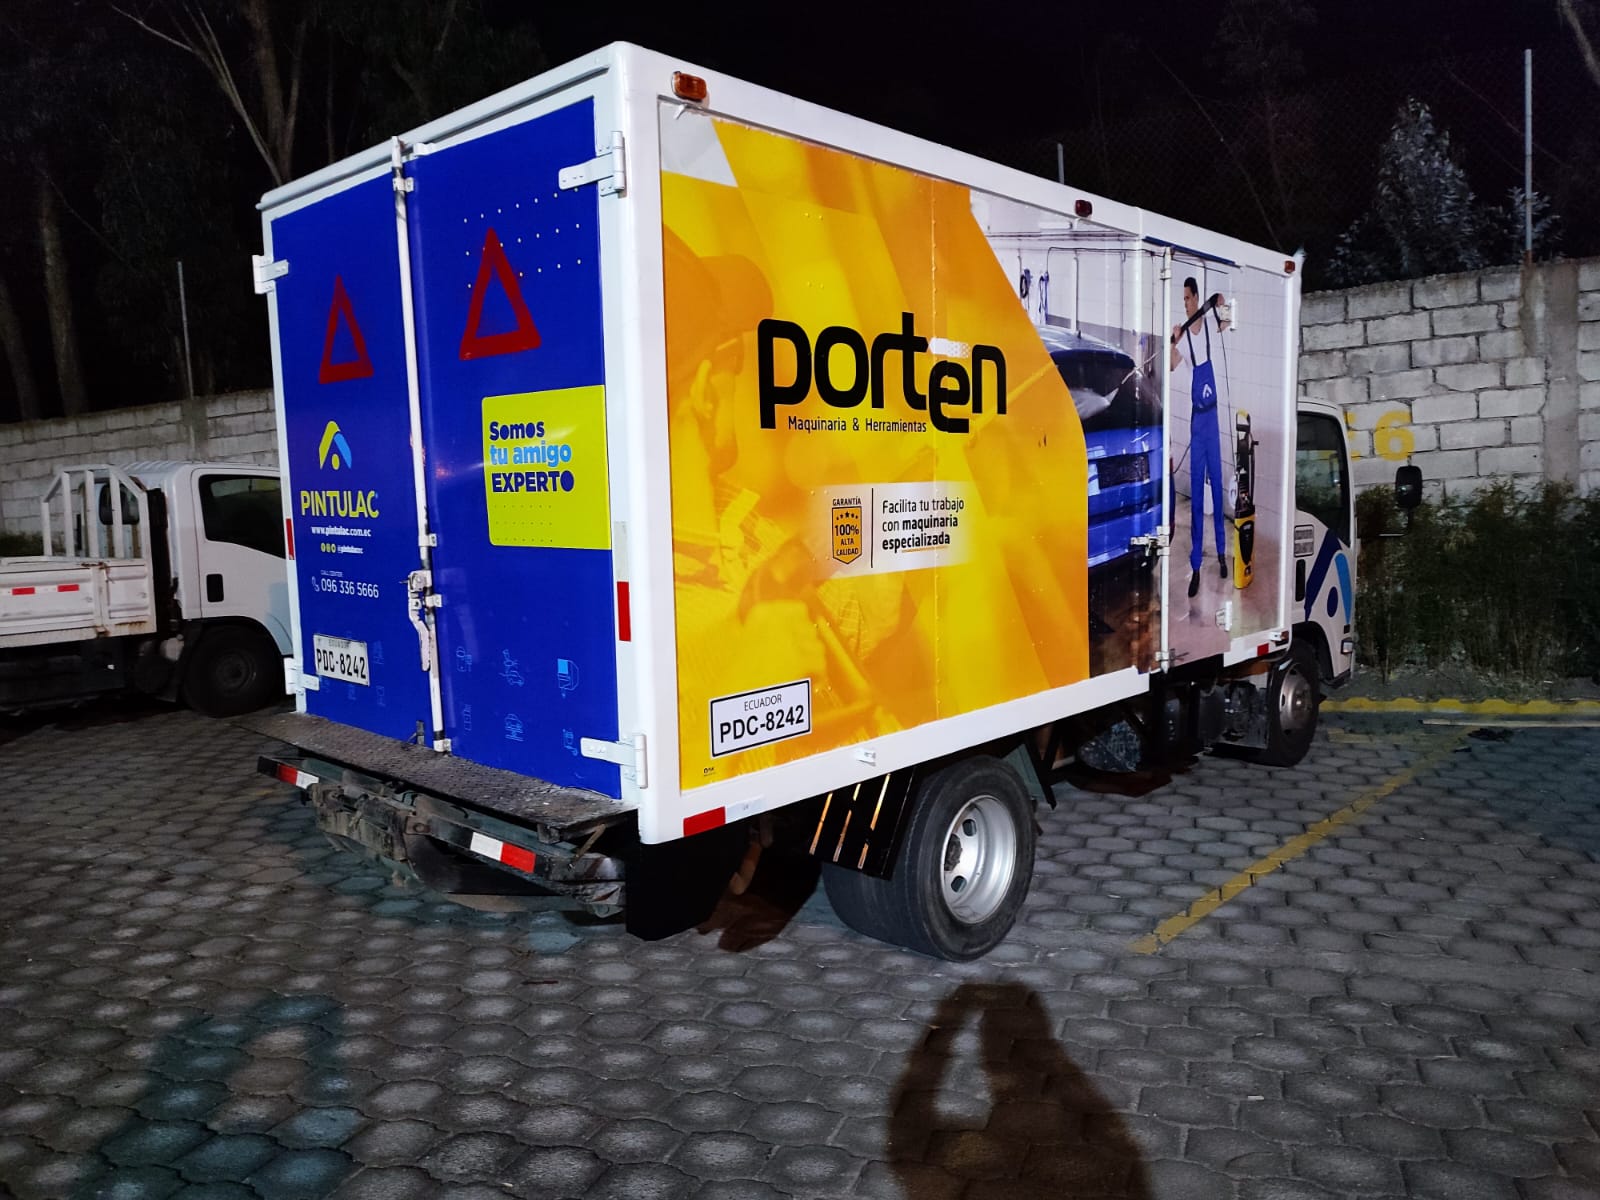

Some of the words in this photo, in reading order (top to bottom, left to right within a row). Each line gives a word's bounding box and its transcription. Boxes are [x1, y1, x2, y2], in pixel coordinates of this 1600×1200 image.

[758, 312, 1007, 433] porten
[489, 421, 545, 441] Somos
[788, 415, 847, 434] Maquinaria
[852, 417, 860, 431] &
[865, 418, 927, 432] Herramientas
[490, 445, 508, 465] tu
[513, 440, 572, 468] amigo
[491, 470, 574, 493] EXPERTO
[300, 490, 379, 518] PINTULAC
[882, 499, 917, 514] Facilita
[919, 500, 930, 511] tu
[932, 497, 965, 513] trabajo
[834, 524, 860, 537] 100%
[882, 520, 900, 532] con
[902, 514, 958, 532] maquinaria
[836, 547, 859, 556] CALIDAD
[840, 538, 855, 546] ALTA
[882, 531, 951, 553] especializada
[321, 578, 338, 592] 096
[339, 580, 355, 595] 336
[357, 582, 379, 598] 5666
[316, 648, 367, 679] PDC-8242
[743, 694, 783, 711] ECUADOR
[719, 704, 805, 743] PDC-8242
